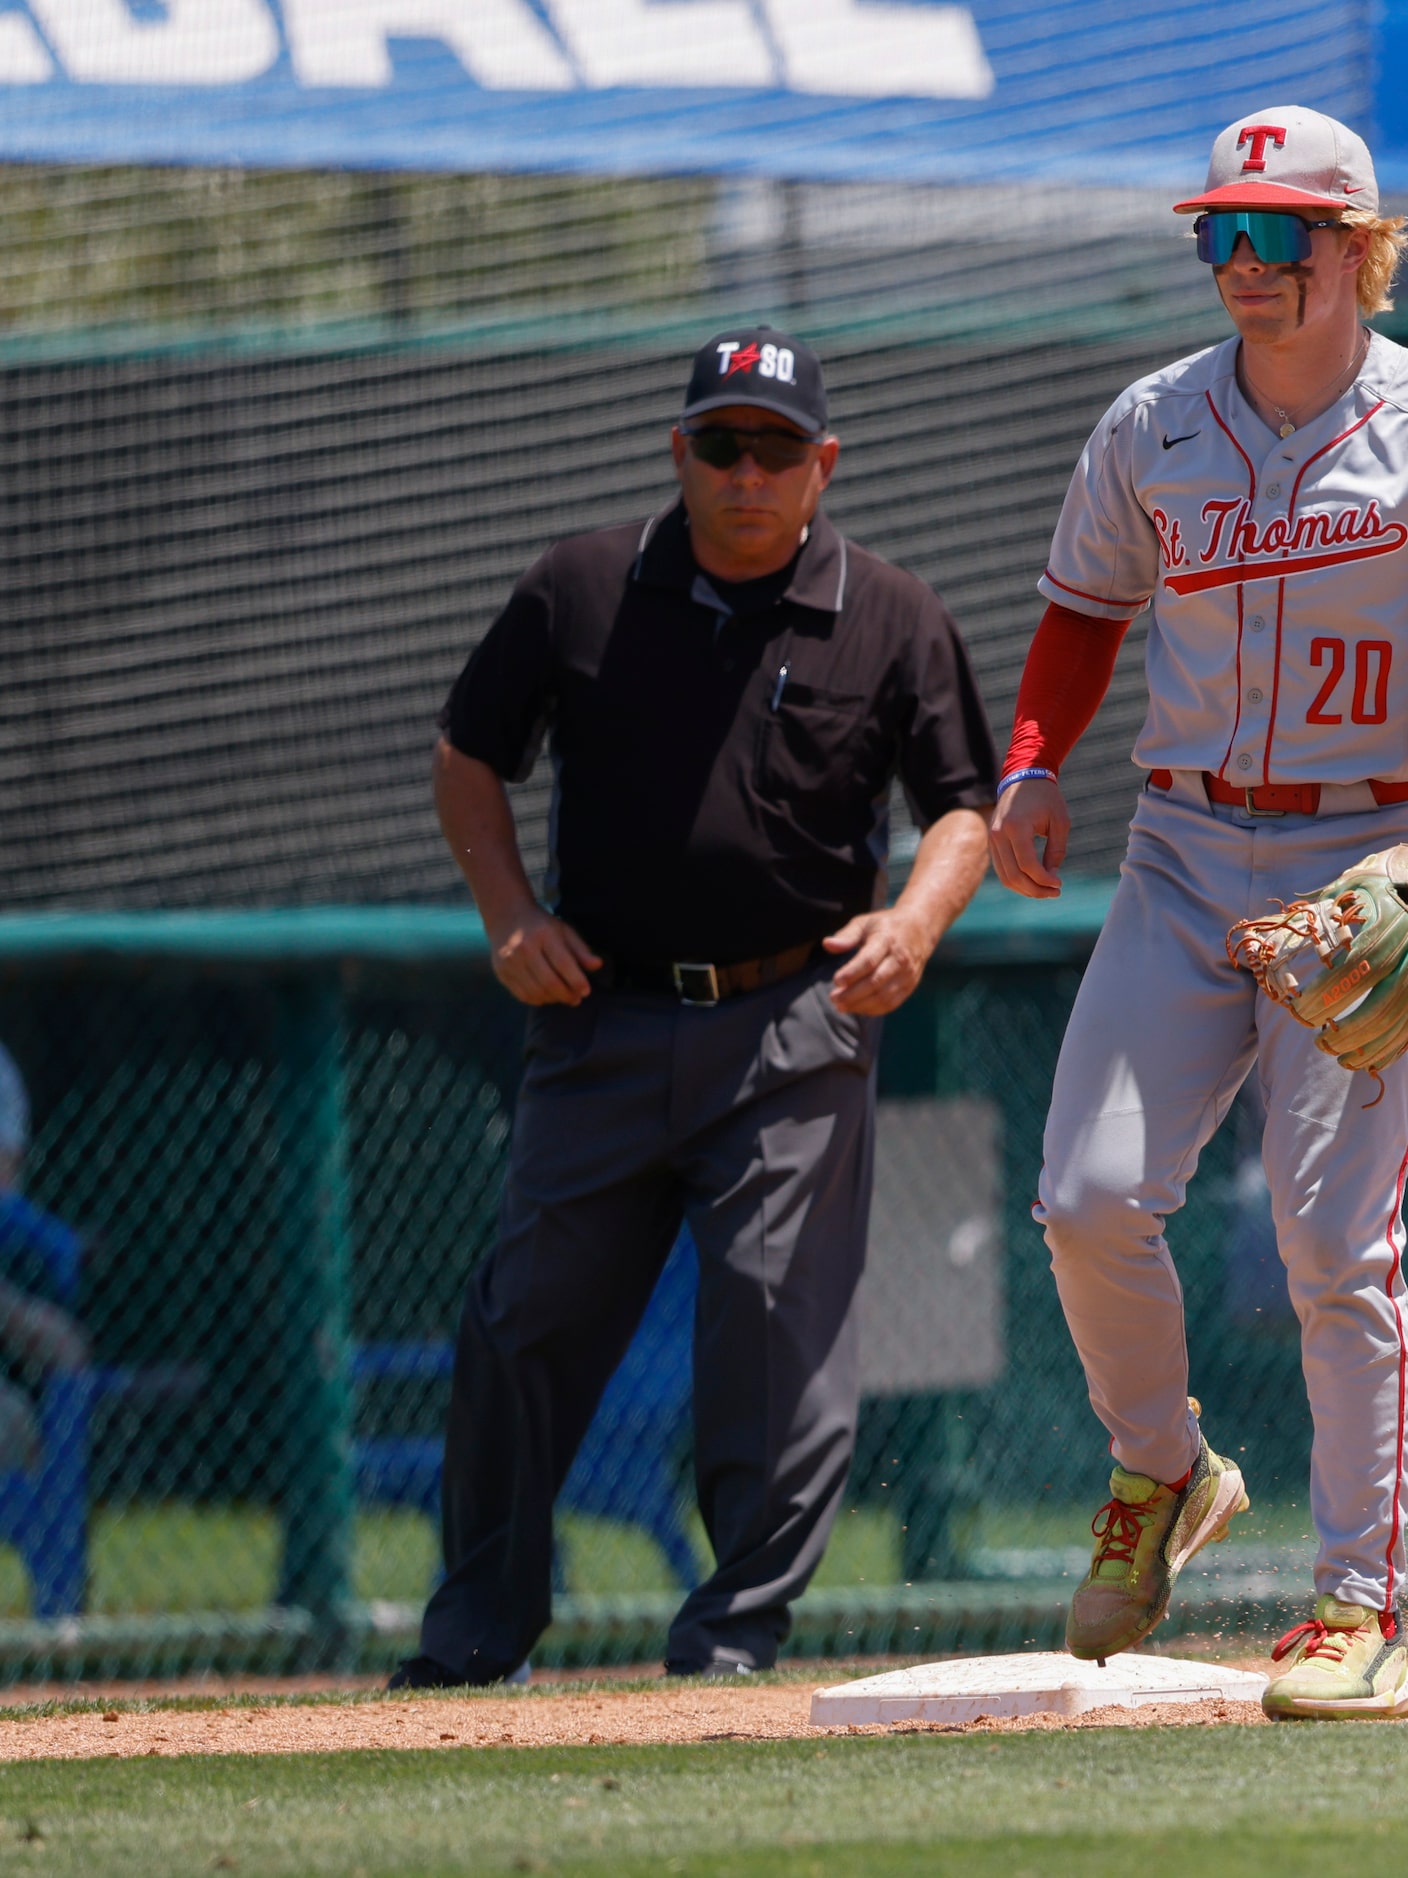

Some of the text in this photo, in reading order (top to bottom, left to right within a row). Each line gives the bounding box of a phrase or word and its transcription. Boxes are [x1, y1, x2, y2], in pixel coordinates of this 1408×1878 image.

[1237, 125, 1287, 171] T
[1153, 497, 1386, 569] St. Thomas
[1306, 637, 1392, 724] 20
[1321, 960, 1371, 1007] A2000
